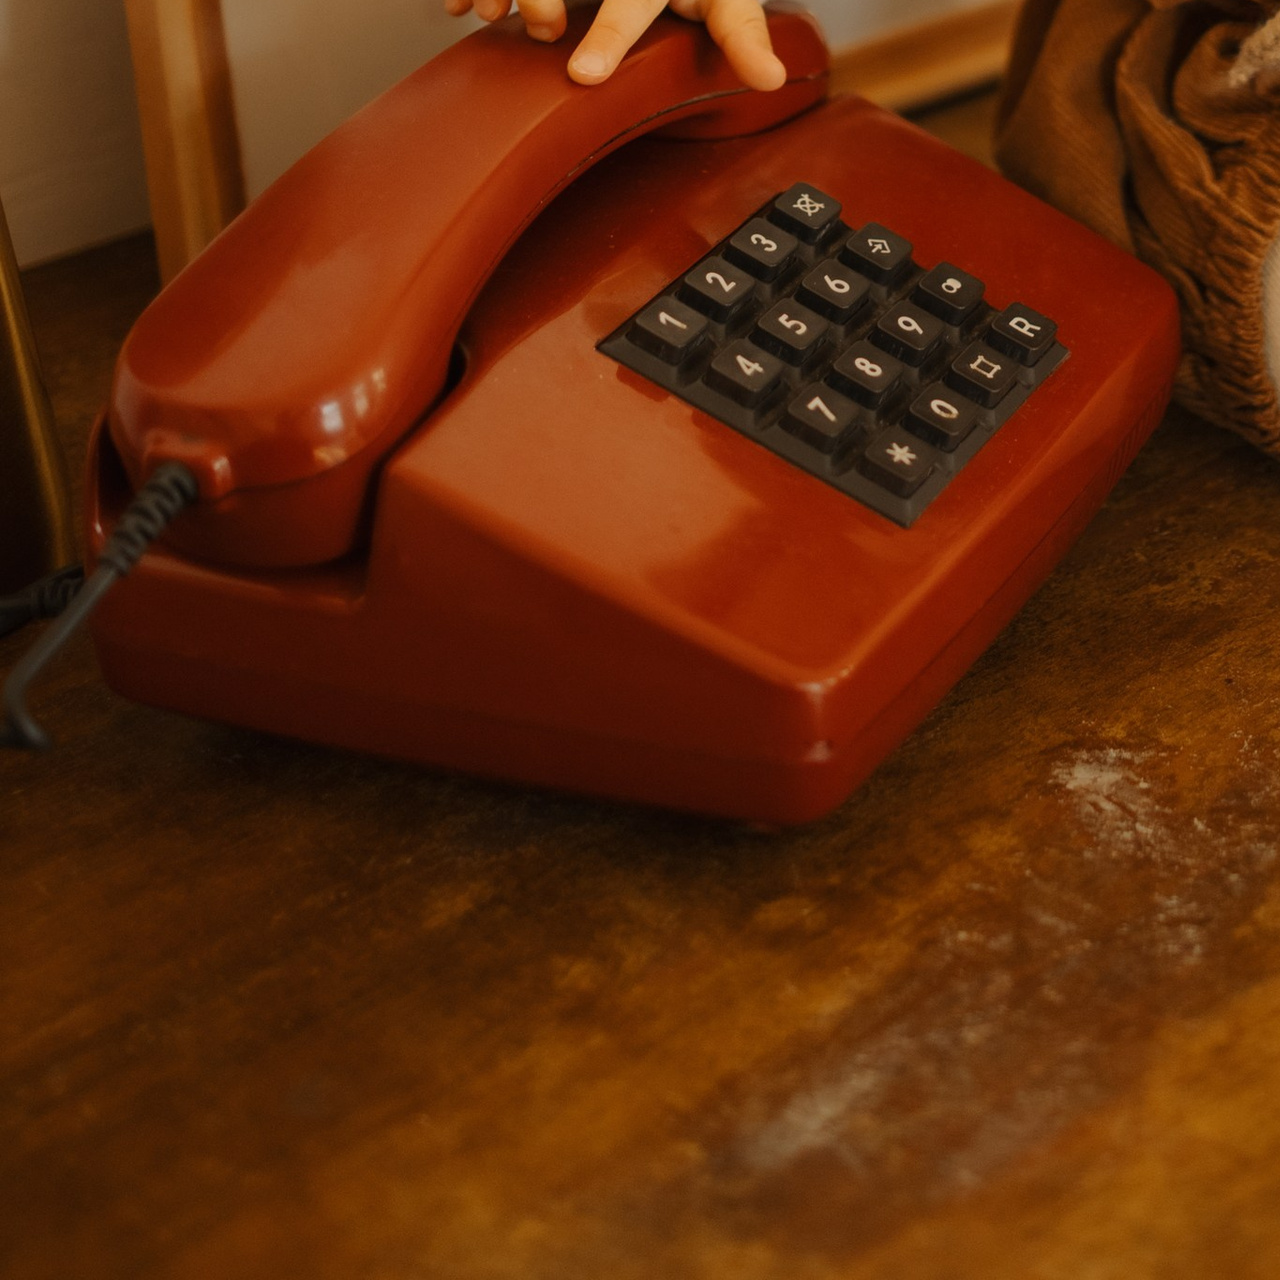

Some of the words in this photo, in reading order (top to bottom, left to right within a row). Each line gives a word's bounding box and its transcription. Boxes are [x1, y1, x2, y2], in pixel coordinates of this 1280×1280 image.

[658, 311, 687, 330] 1
[705, 272, 737, 293] 2
[750, 233, 778, 252] 3
[736, 354, 764, 376] 4
[778, 313, 808, 335] 5
[823, 274, 851, 294] 6
[1008, 316, 1041, 338] R
[807, 396, 836, 422] 7
[854, 357, 883, 377] 8
[897, 316, 924, 335] 9
[930, 399, 959, 418] 0
